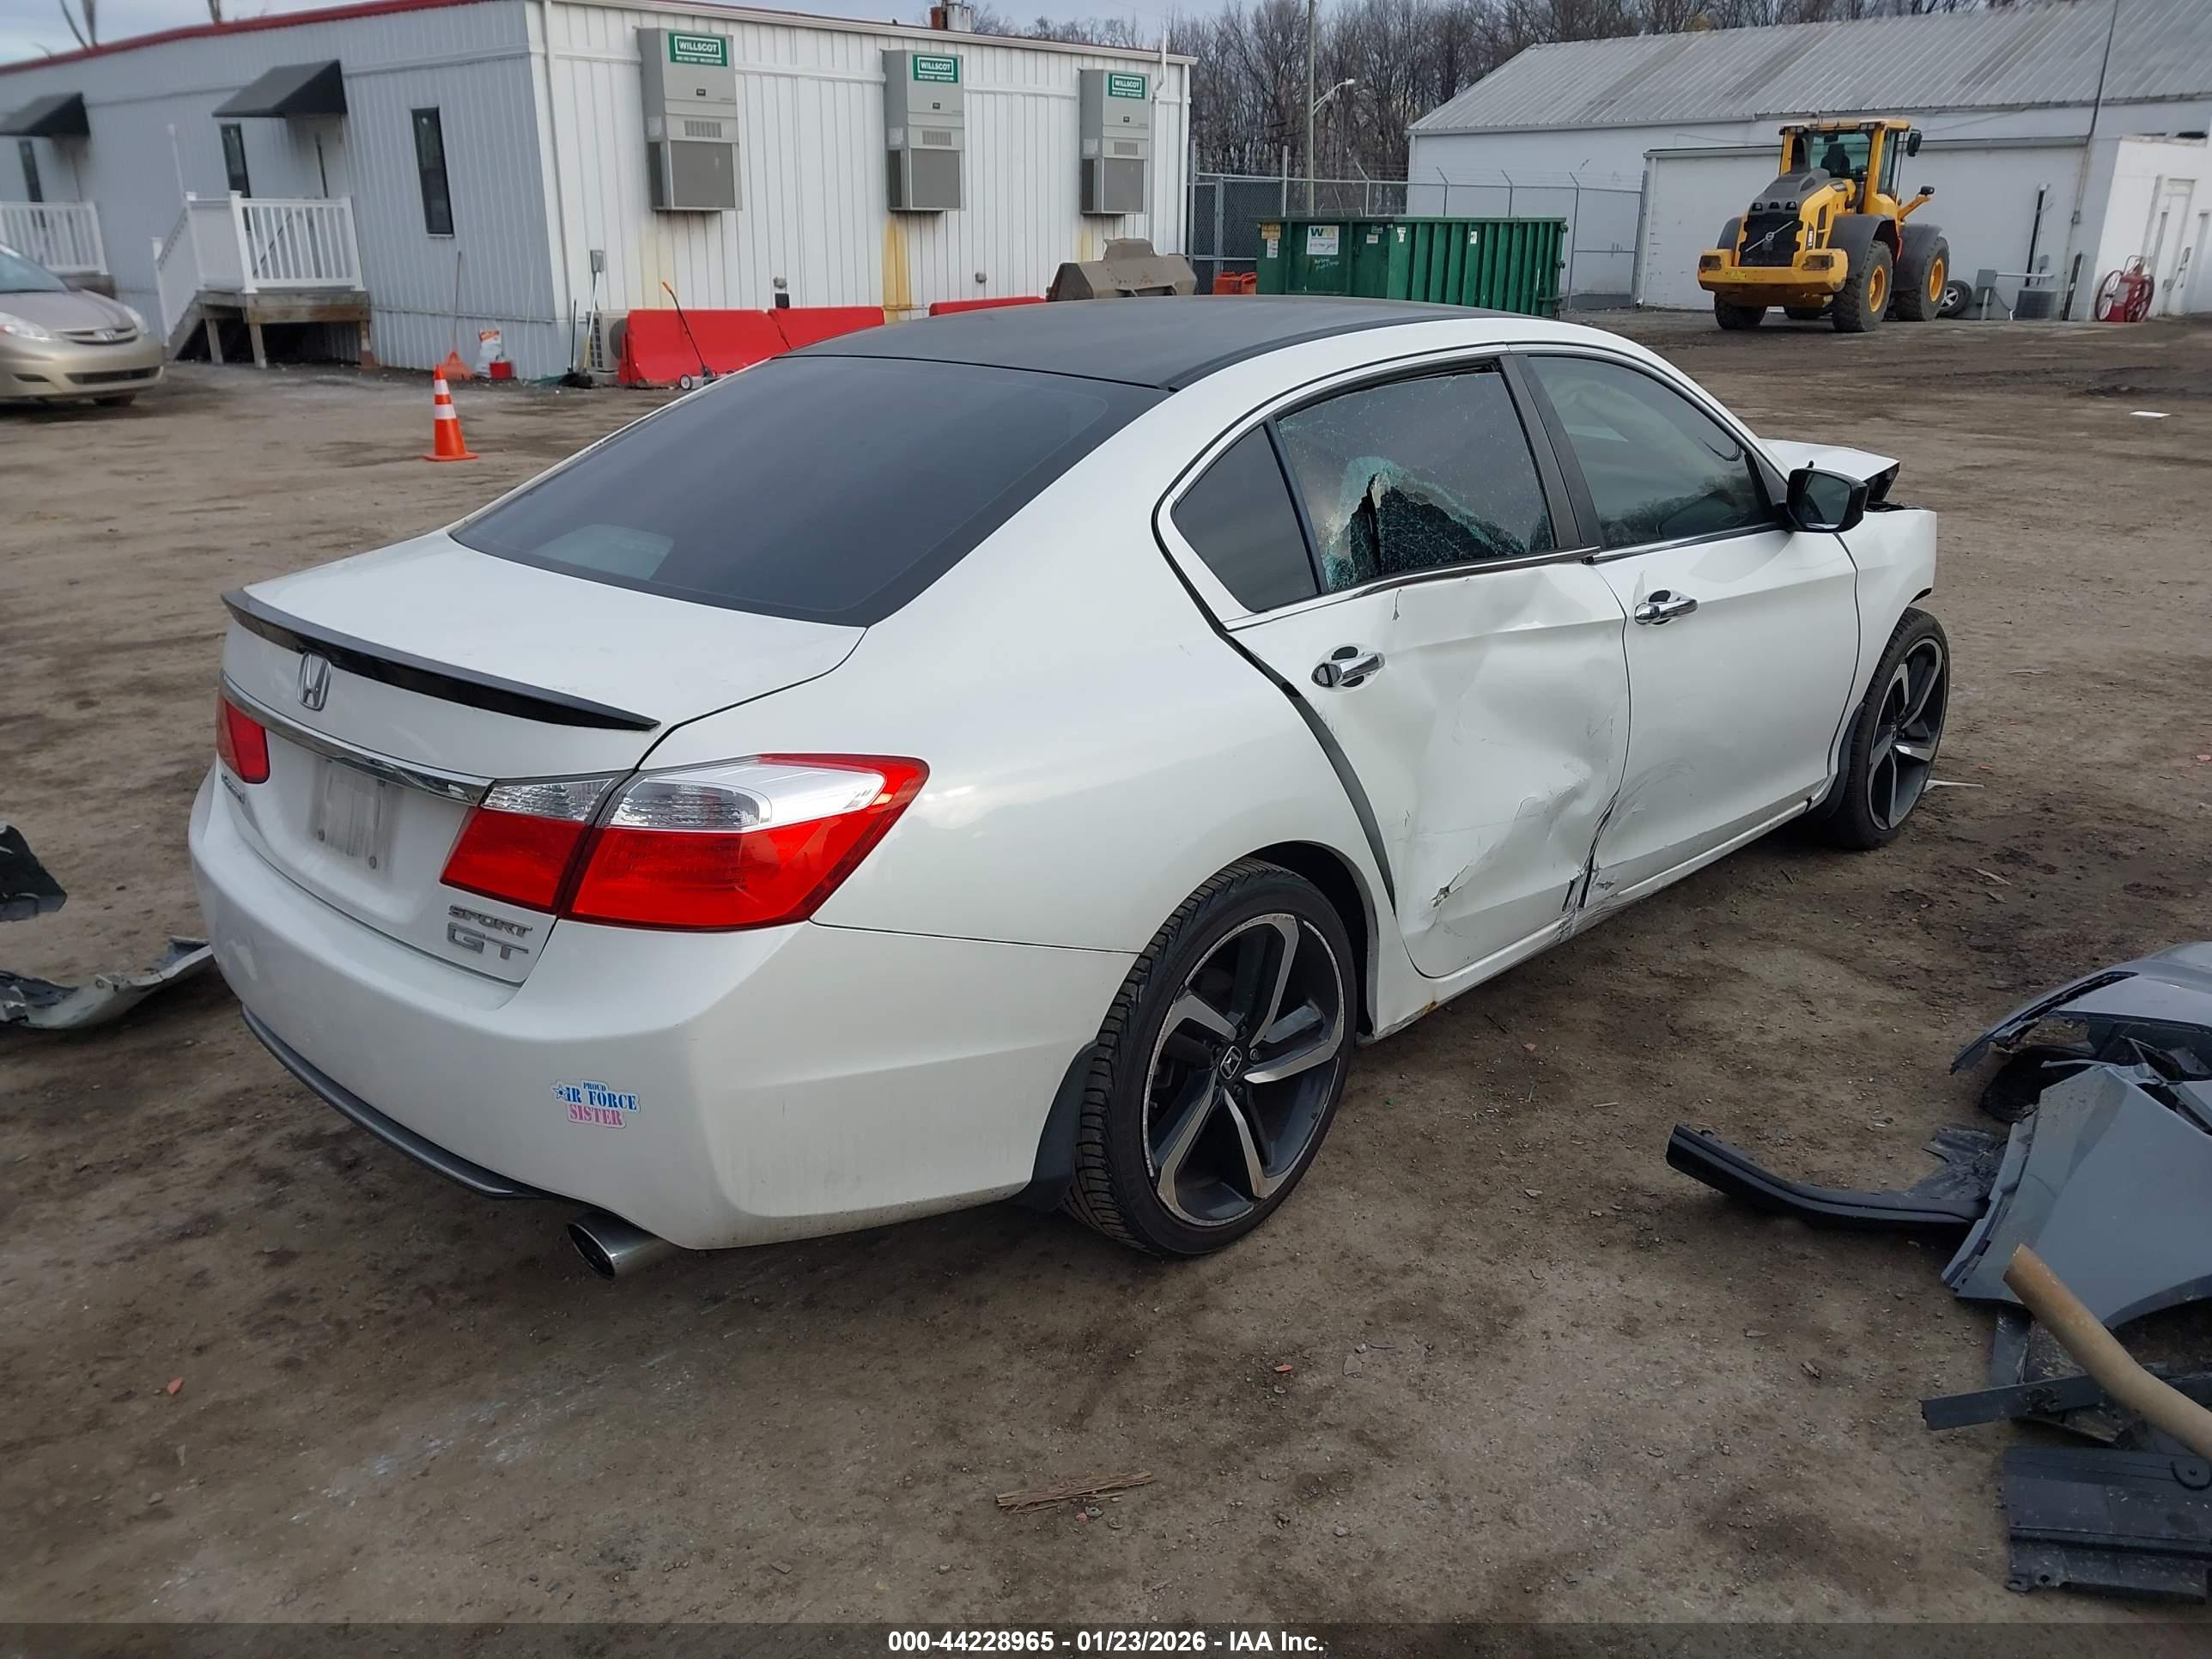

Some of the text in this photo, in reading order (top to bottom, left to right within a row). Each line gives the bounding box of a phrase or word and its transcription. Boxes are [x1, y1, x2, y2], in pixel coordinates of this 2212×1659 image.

[678, 40, 718, 52] WILLSCOT
[920, 61, 951, 70] WILLSCOT
[1115, 79, 1139, 88] WILLSCOT
[448, 905, 533, 937] SPORT
[447, 921, 529, 960] GT
[583, 1082, 606, 1091] PROUD
[588, 1091, 637, 1110] FORCE
[569, 1104, 623, 1126] SISTER
